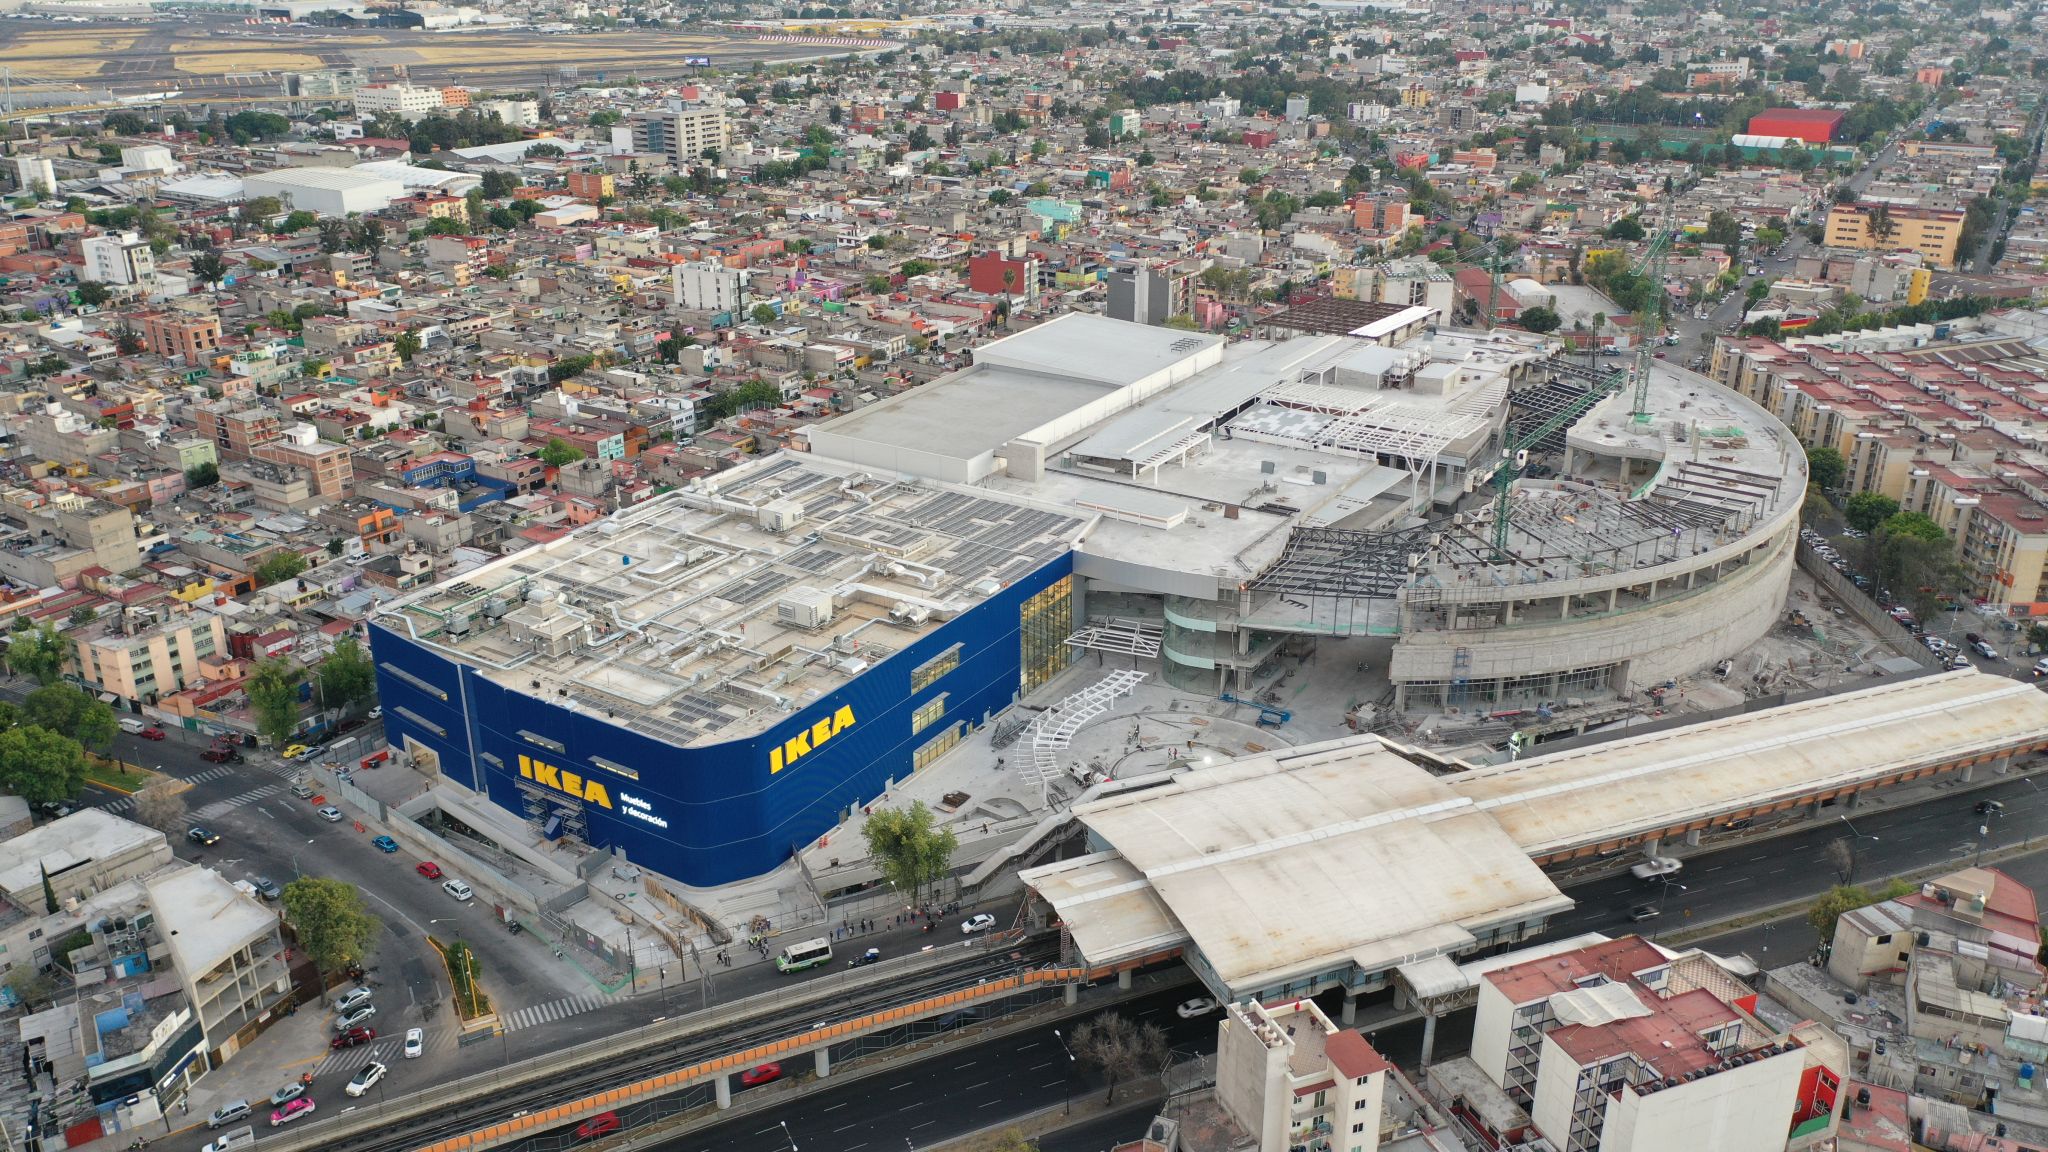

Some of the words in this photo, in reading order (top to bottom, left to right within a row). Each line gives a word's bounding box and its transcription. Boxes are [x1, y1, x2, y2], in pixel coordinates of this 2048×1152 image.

[769, 704, 856, 775] IKEA
[518, 754, 612, 809] IKEA
[620, 792, 652, 811] Muebles
[622, 805, 628, 815] y
[628, 806, 668, 829] decoración
